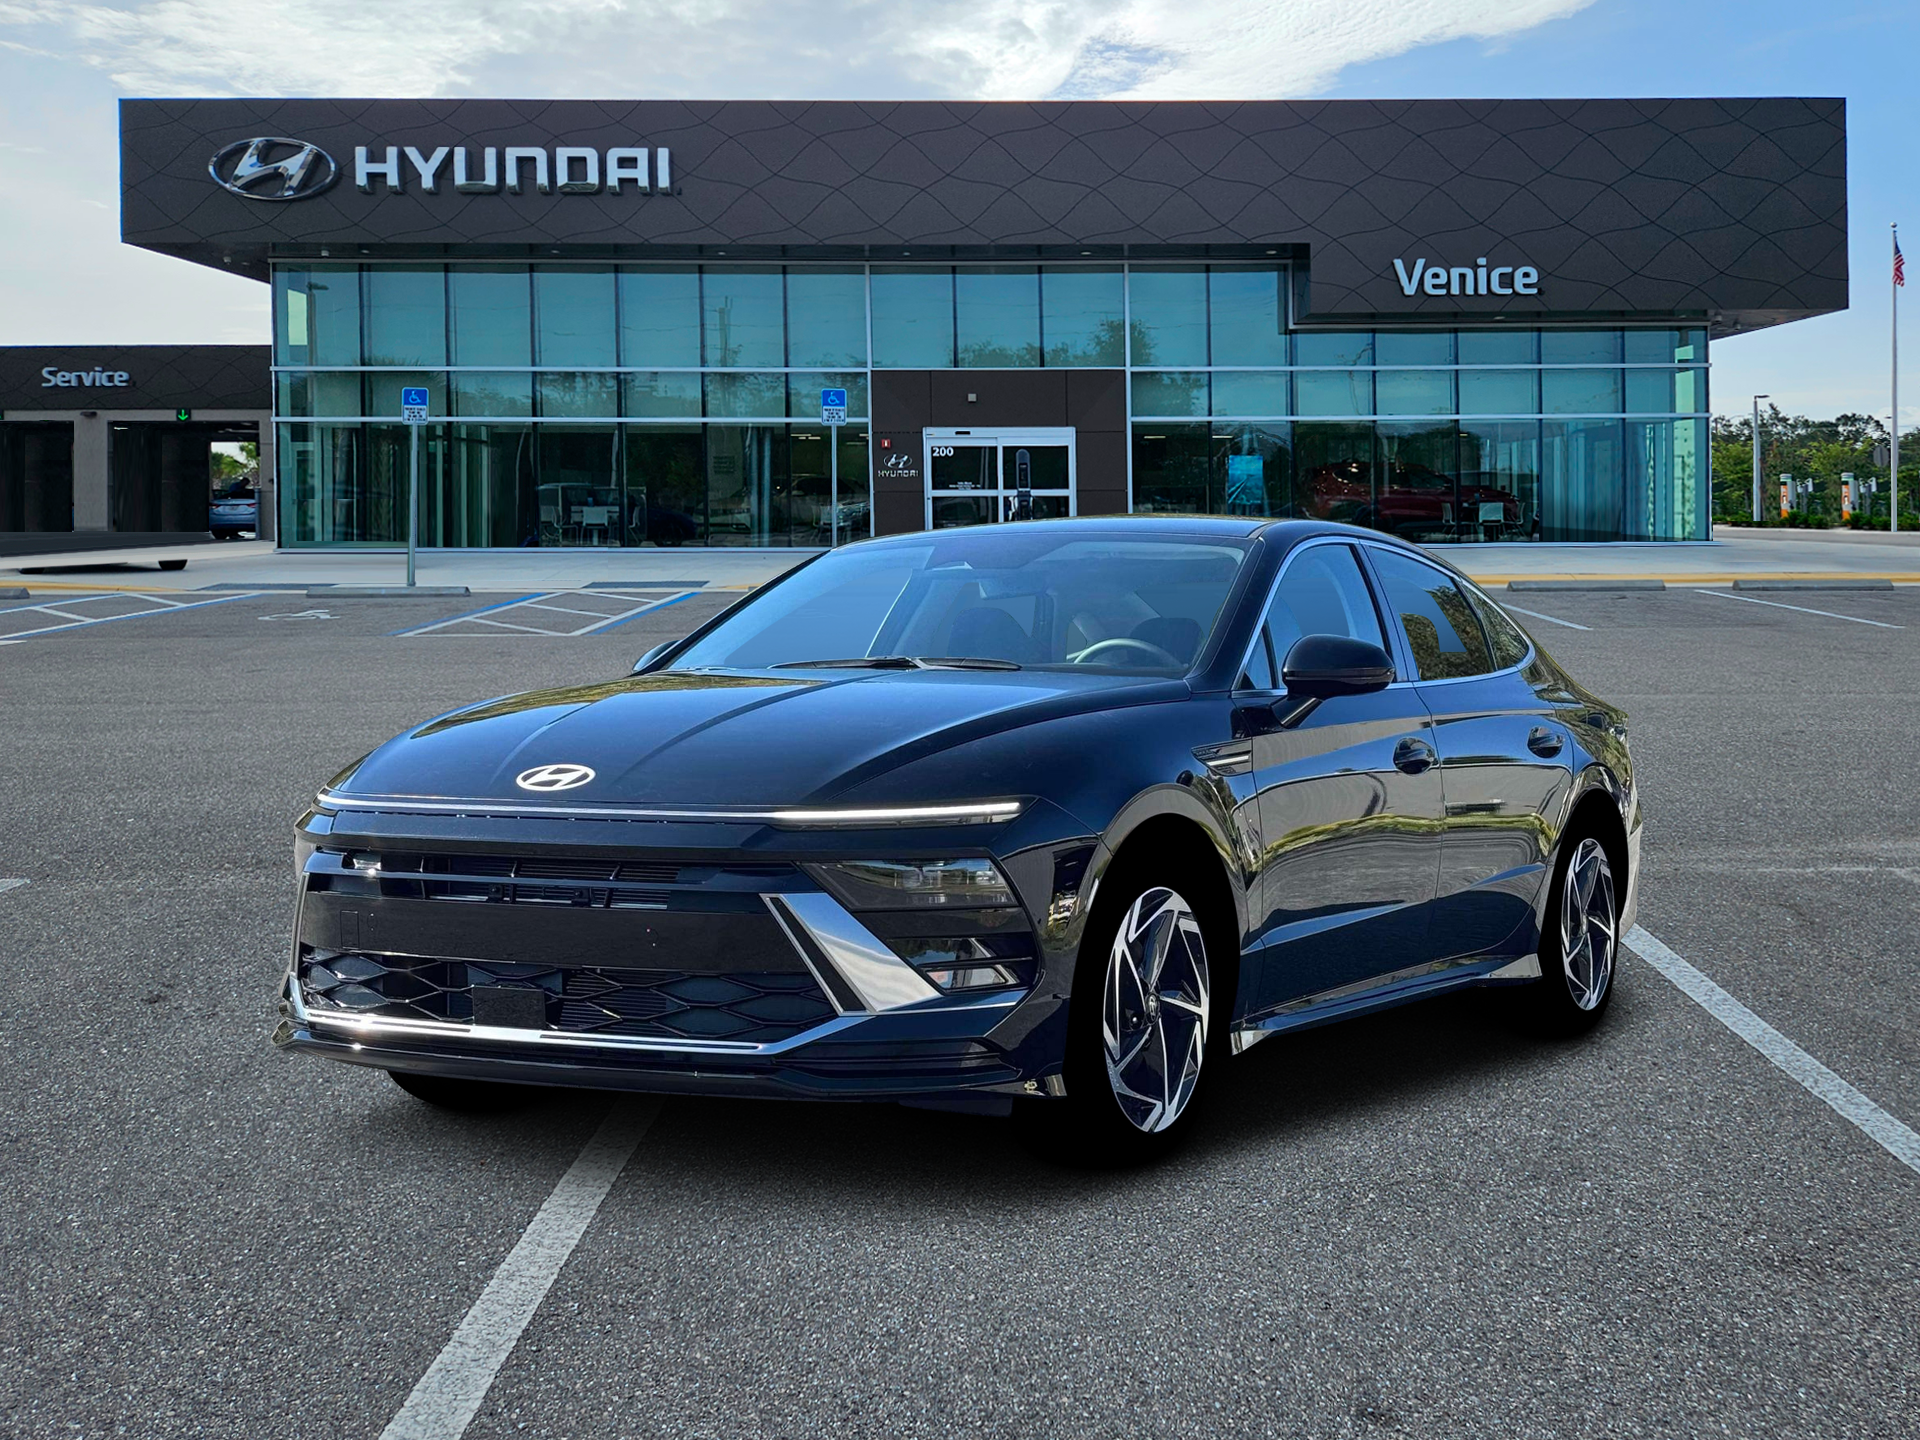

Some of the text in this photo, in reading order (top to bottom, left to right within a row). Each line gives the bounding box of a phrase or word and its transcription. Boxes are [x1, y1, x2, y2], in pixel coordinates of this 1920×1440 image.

[355, 146, 671, 193] HYUNDAI
[1393, 257, 1538, 296] Venice
[41, 366, 130, 387] Service
[932, 446, 954, 457] 200
[877, 470, 919, 478] HYUNDAI
